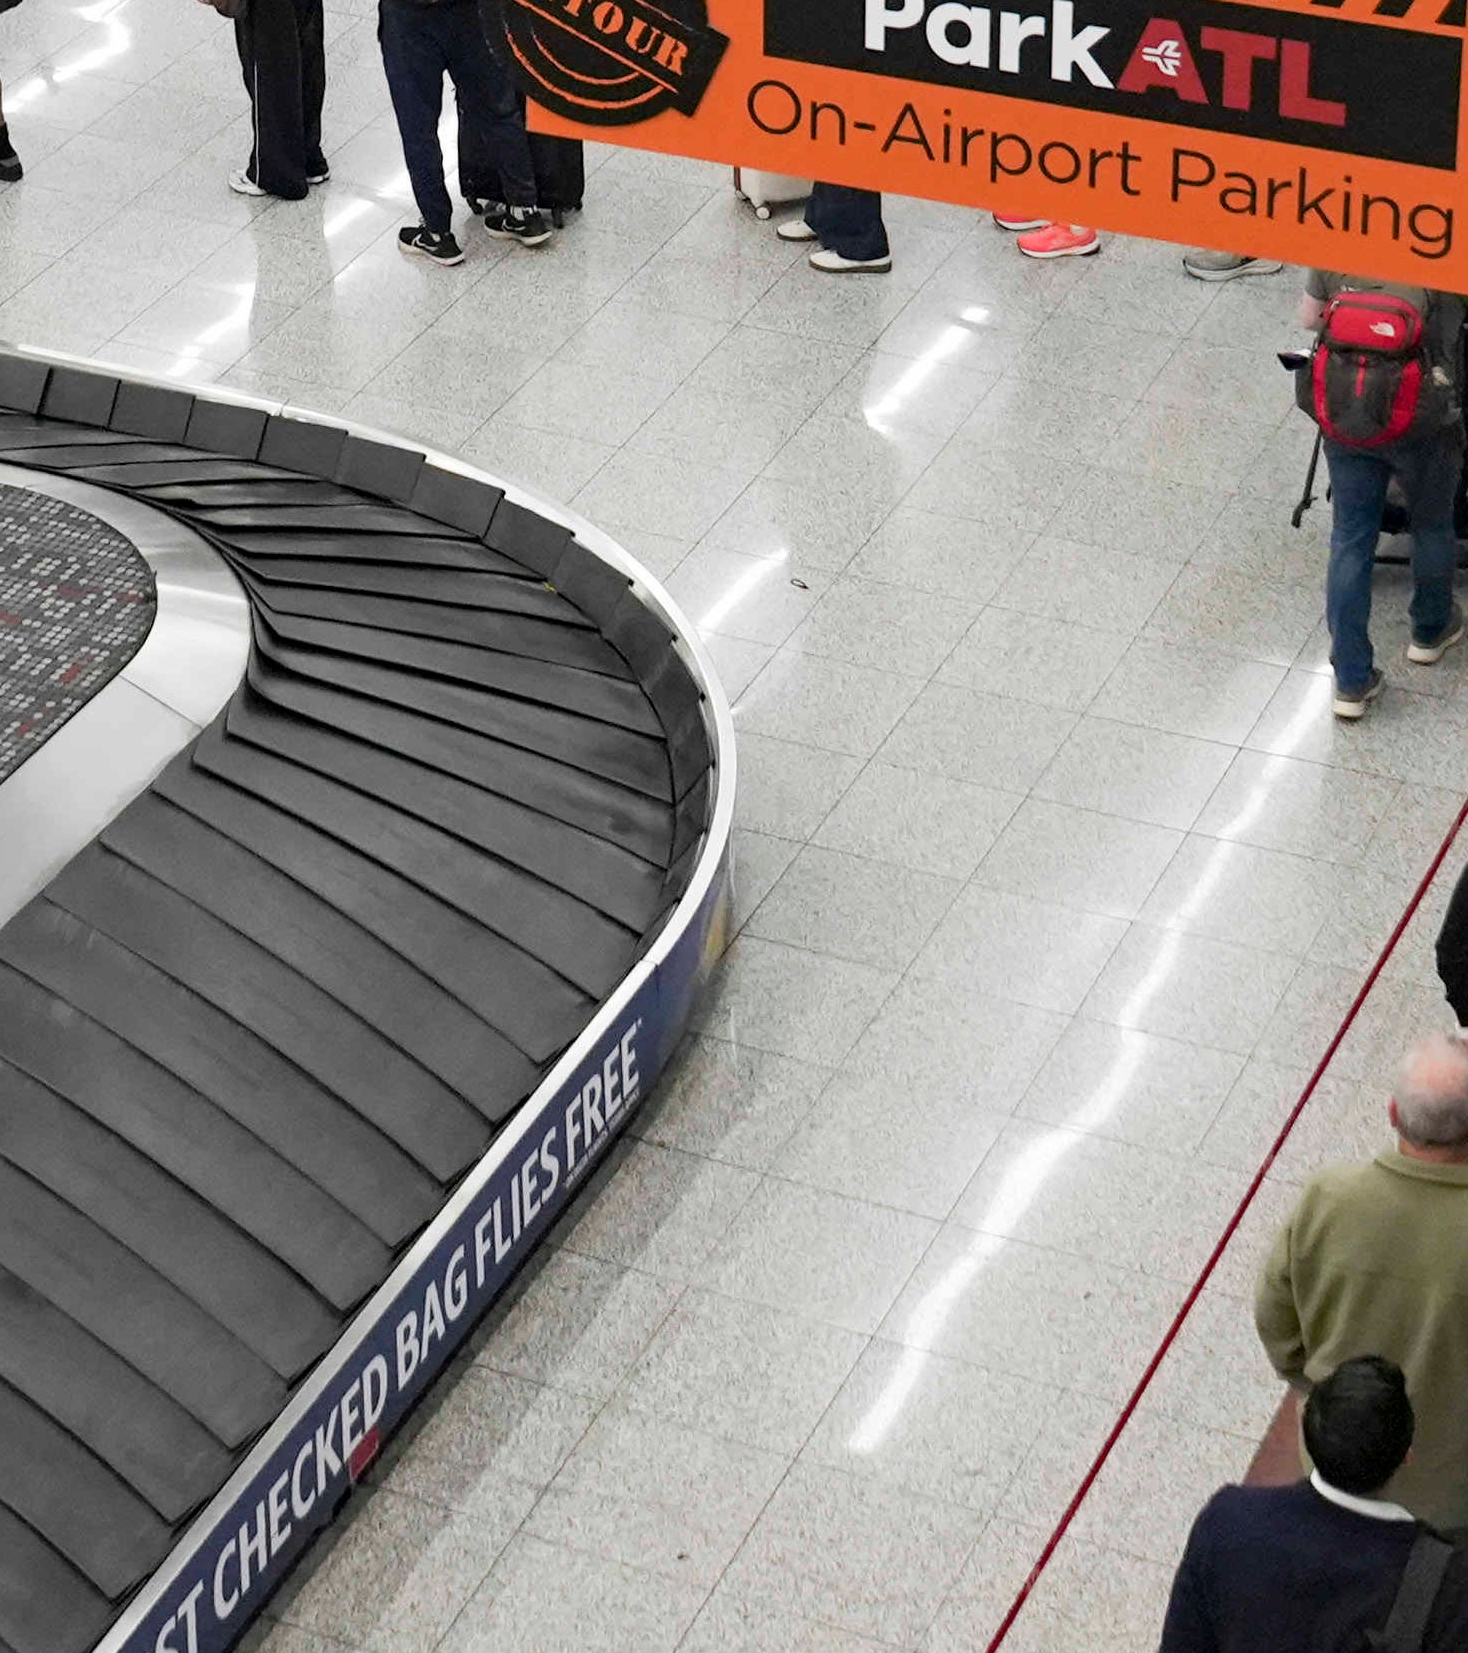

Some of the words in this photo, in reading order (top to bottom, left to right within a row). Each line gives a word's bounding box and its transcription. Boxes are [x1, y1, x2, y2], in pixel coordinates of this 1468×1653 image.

[746, 78, 1142, 198] On-Airport
[1170, 148, 1455, 259] Parking
[211, 1352, 390, 1621] CHECKED
[394, 1243, 469, 1392] BAG
[473, 1126, 560, 1290] FLIES
